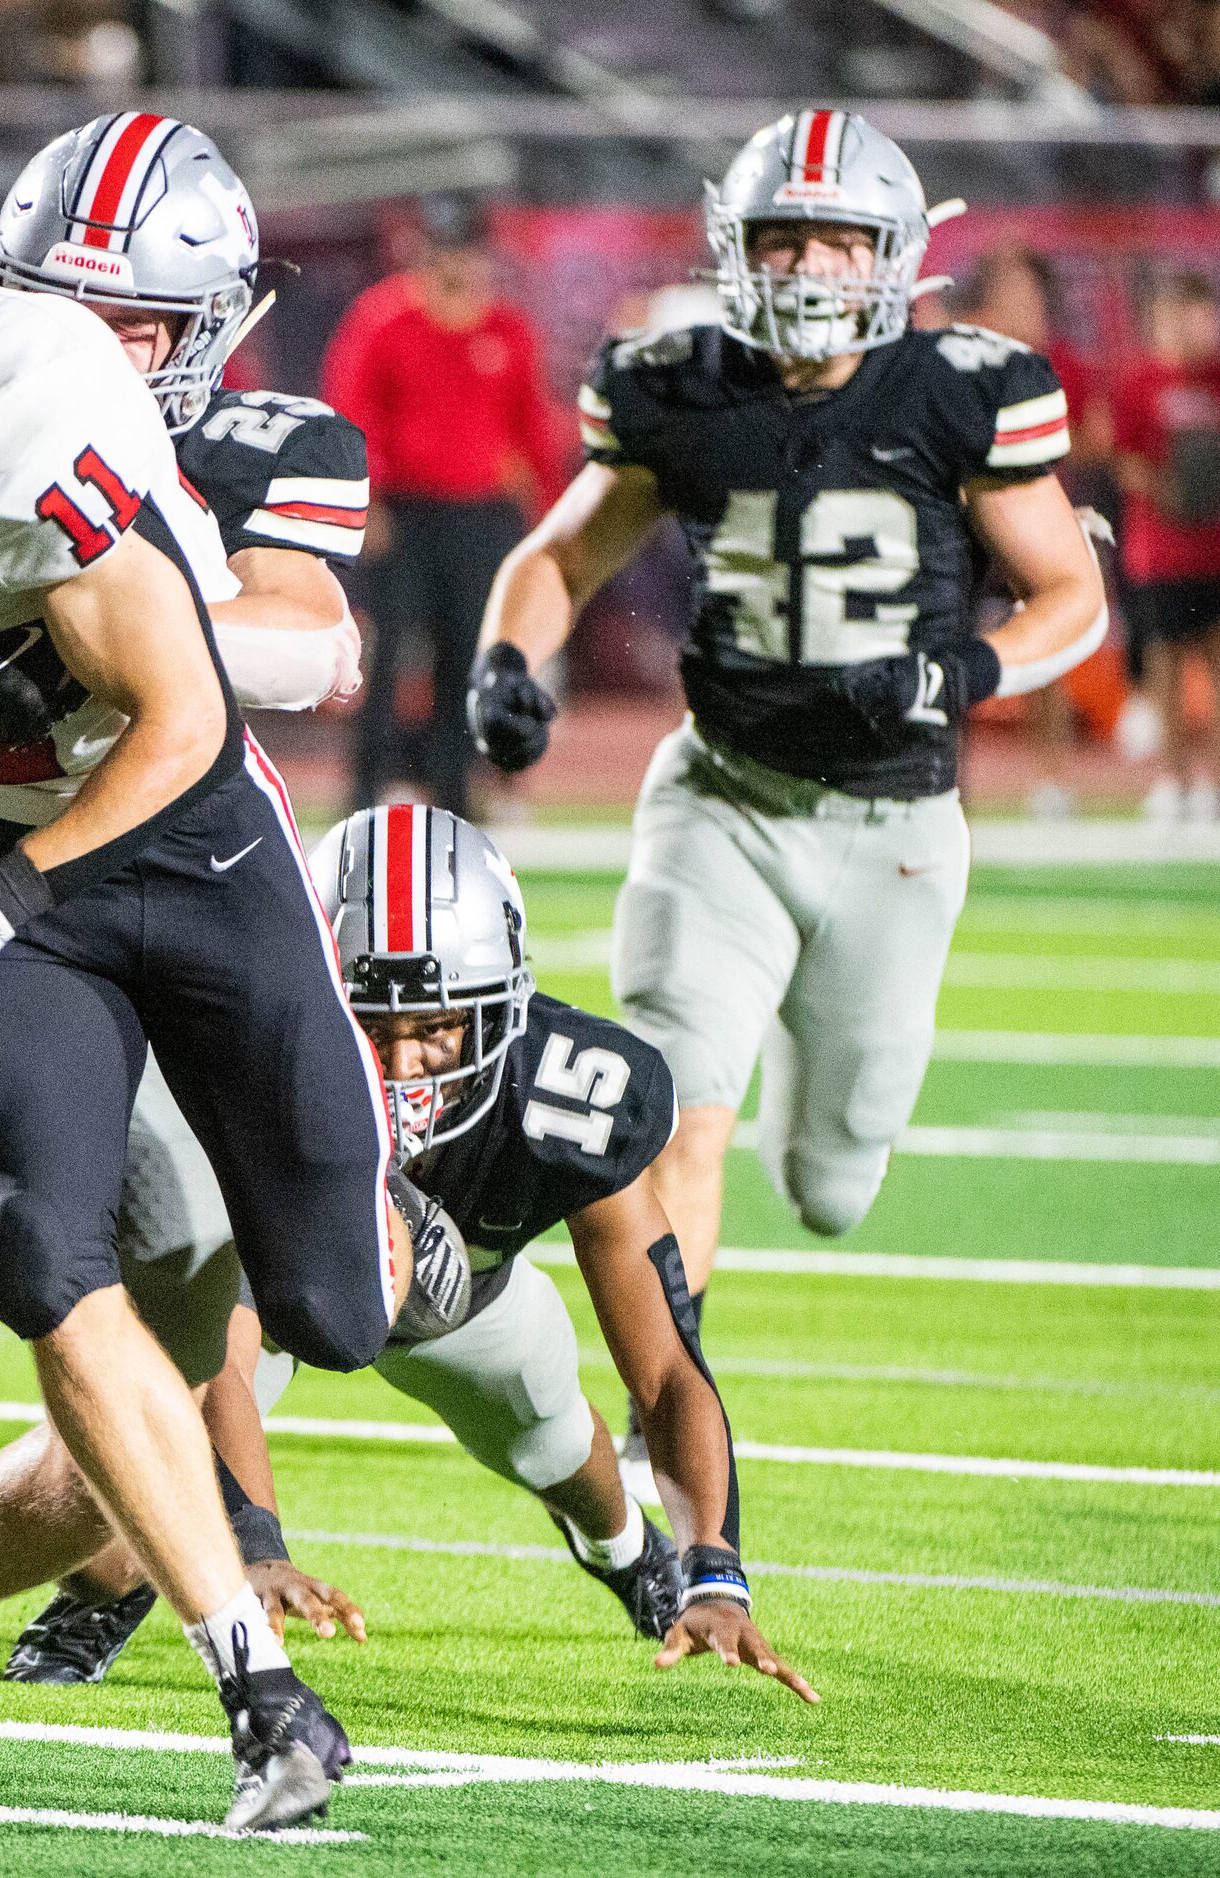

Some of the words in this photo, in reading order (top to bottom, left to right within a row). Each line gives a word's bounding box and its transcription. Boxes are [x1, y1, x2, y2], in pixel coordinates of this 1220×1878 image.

[202, 390, 335, 454] 23
[35, 443, 140, 569] 11
[703, 489, 920, 668] 42
[522, 1032, 631, 1157] 15
